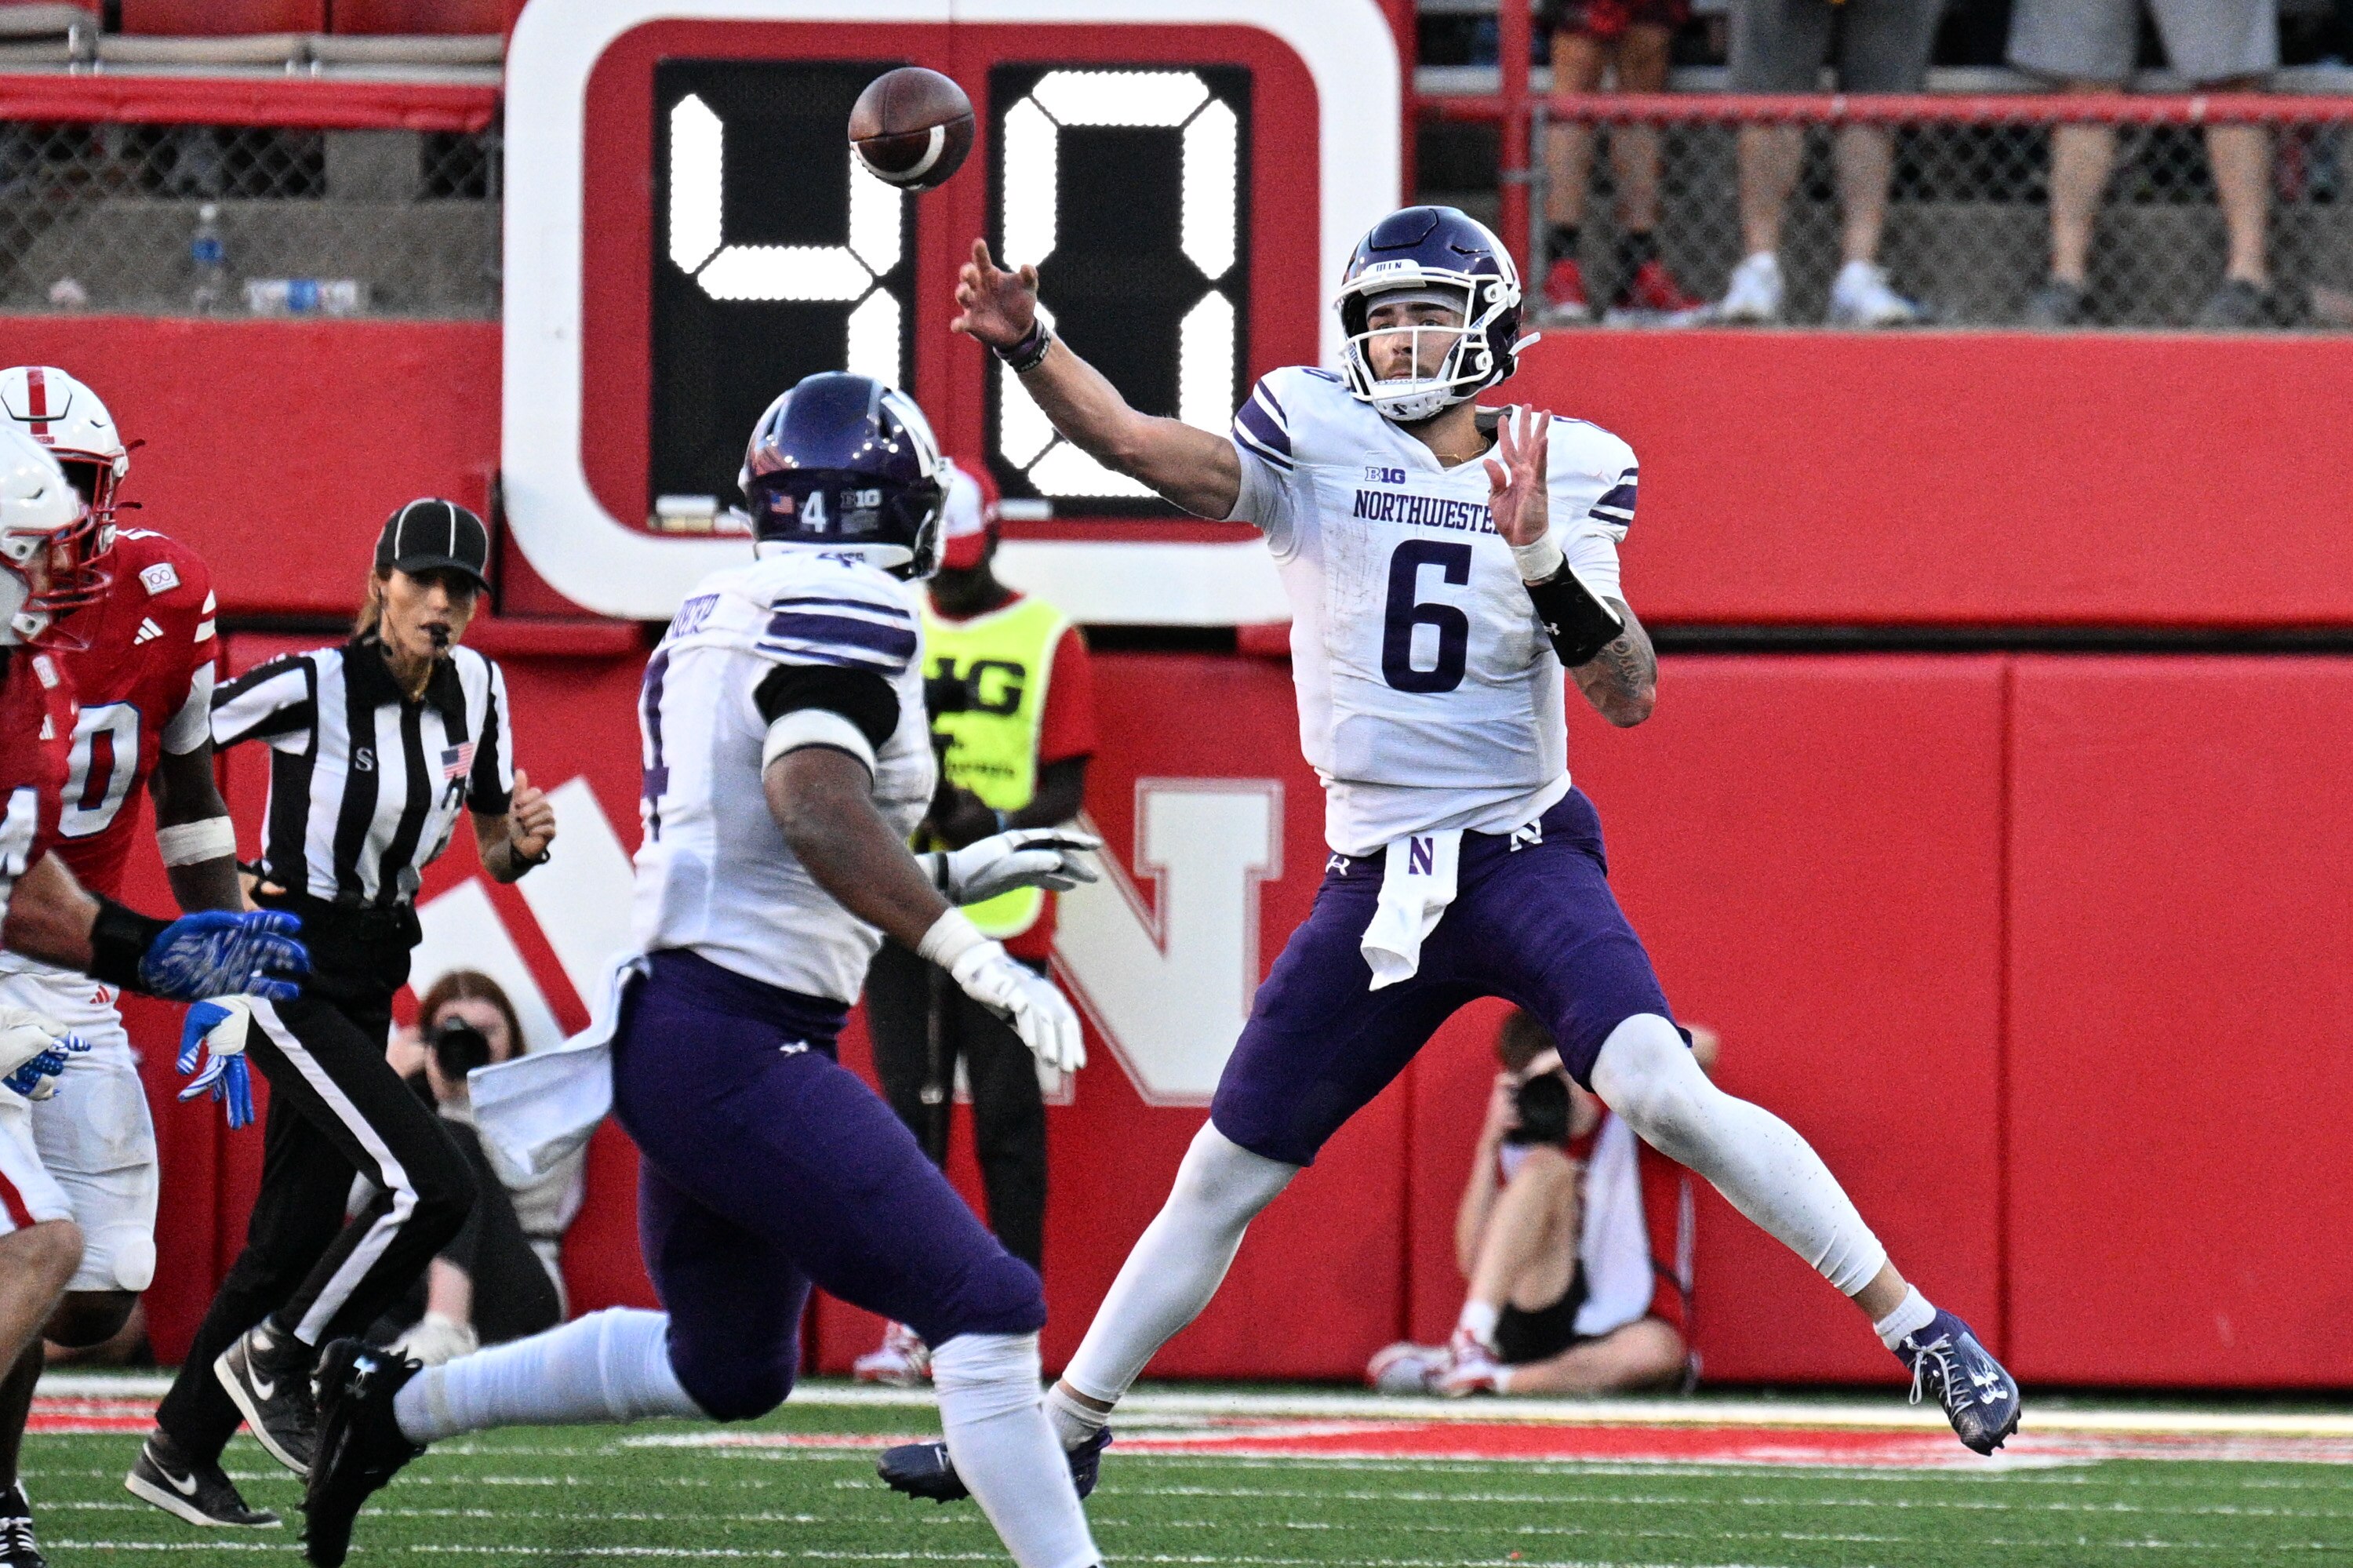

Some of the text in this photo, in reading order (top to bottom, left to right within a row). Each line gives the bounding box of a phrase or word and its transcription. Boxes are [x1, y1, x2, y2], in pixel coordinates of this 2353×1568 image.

[670, 71, 1237, 497] 40
[801, 490, 827, 533] 4
[1353, 489, 1499, 535] NORTHWESTE
[1381, 539, 1472, 693] 6
[355, 747, 374, 772] S
[1409, 835, 1434, 876] N
